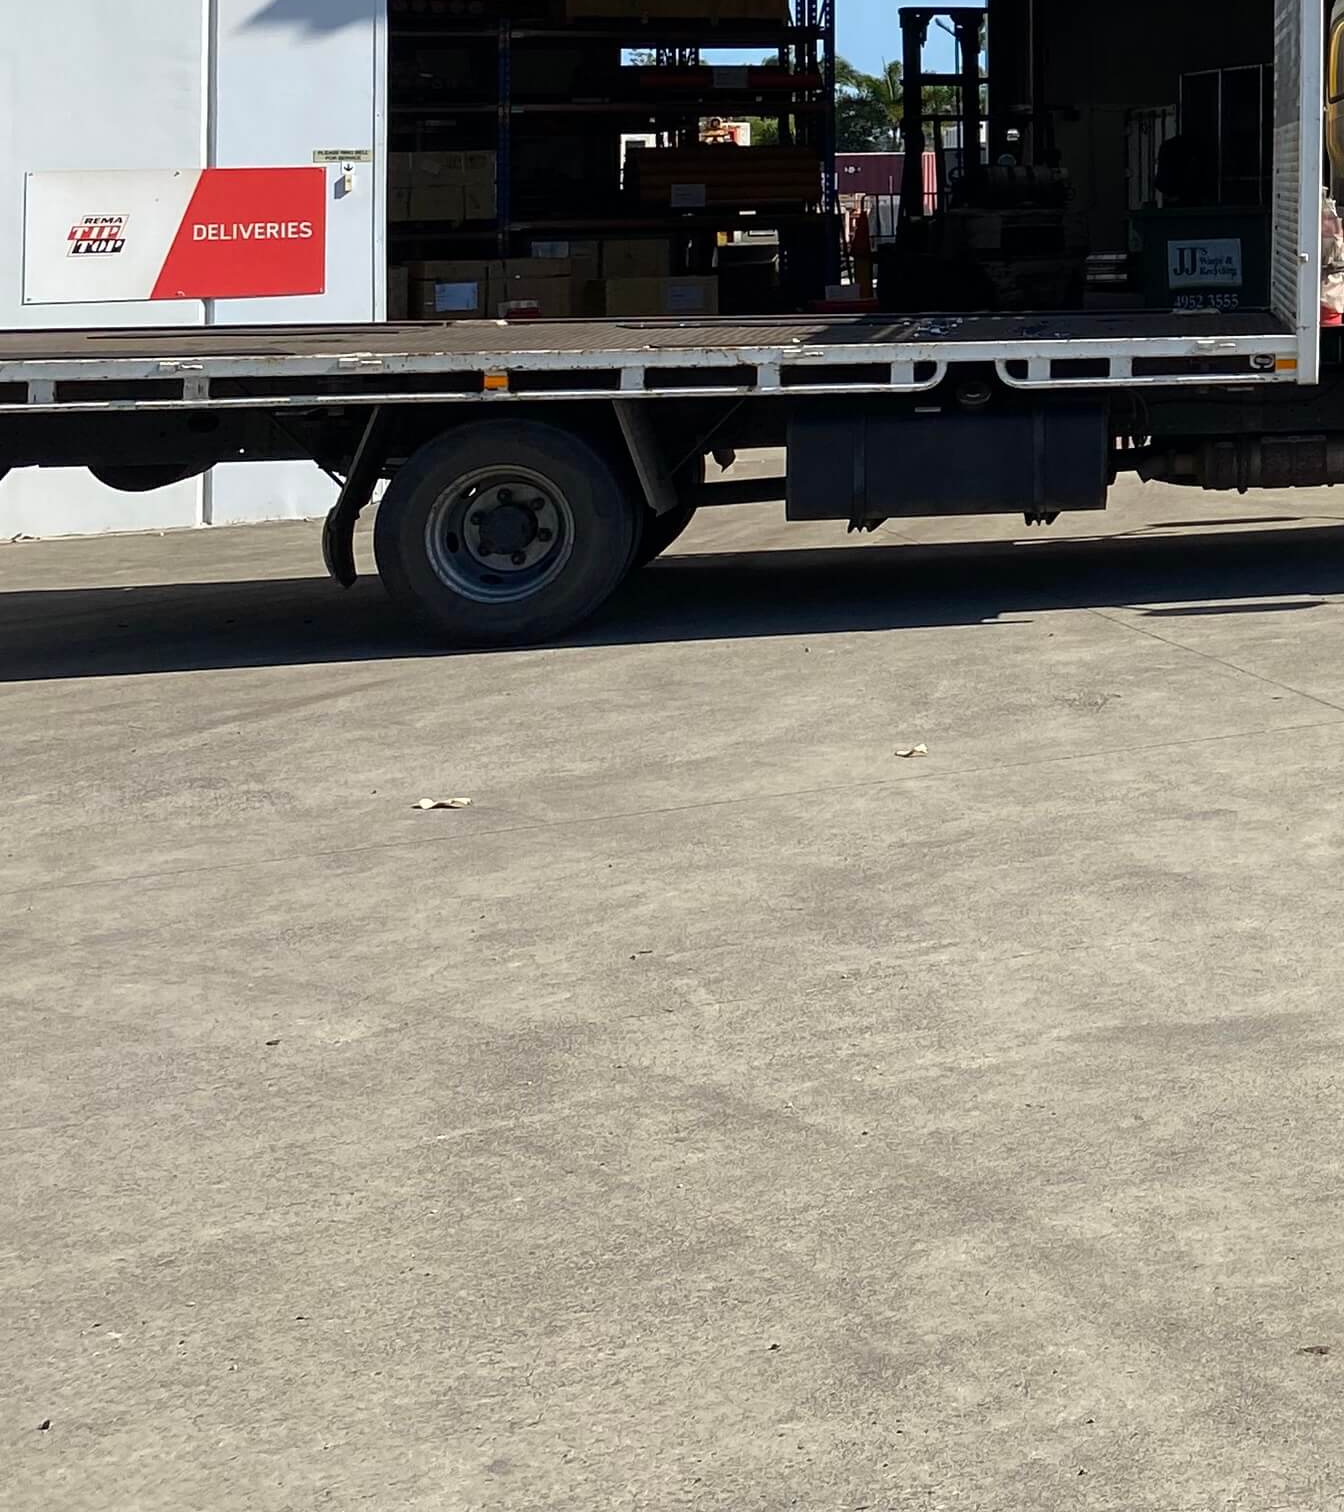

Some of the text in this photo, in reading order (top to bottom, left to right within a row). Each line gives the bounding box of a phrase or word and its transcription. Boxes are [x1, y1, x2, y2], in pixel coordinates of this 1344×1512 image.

[83, 217, 123, 225] REMA
[72, 227, 120, 240] TIP
[193, 221, 313, 241] DELIVERIES
[76, 239, 124, 253] TOP
